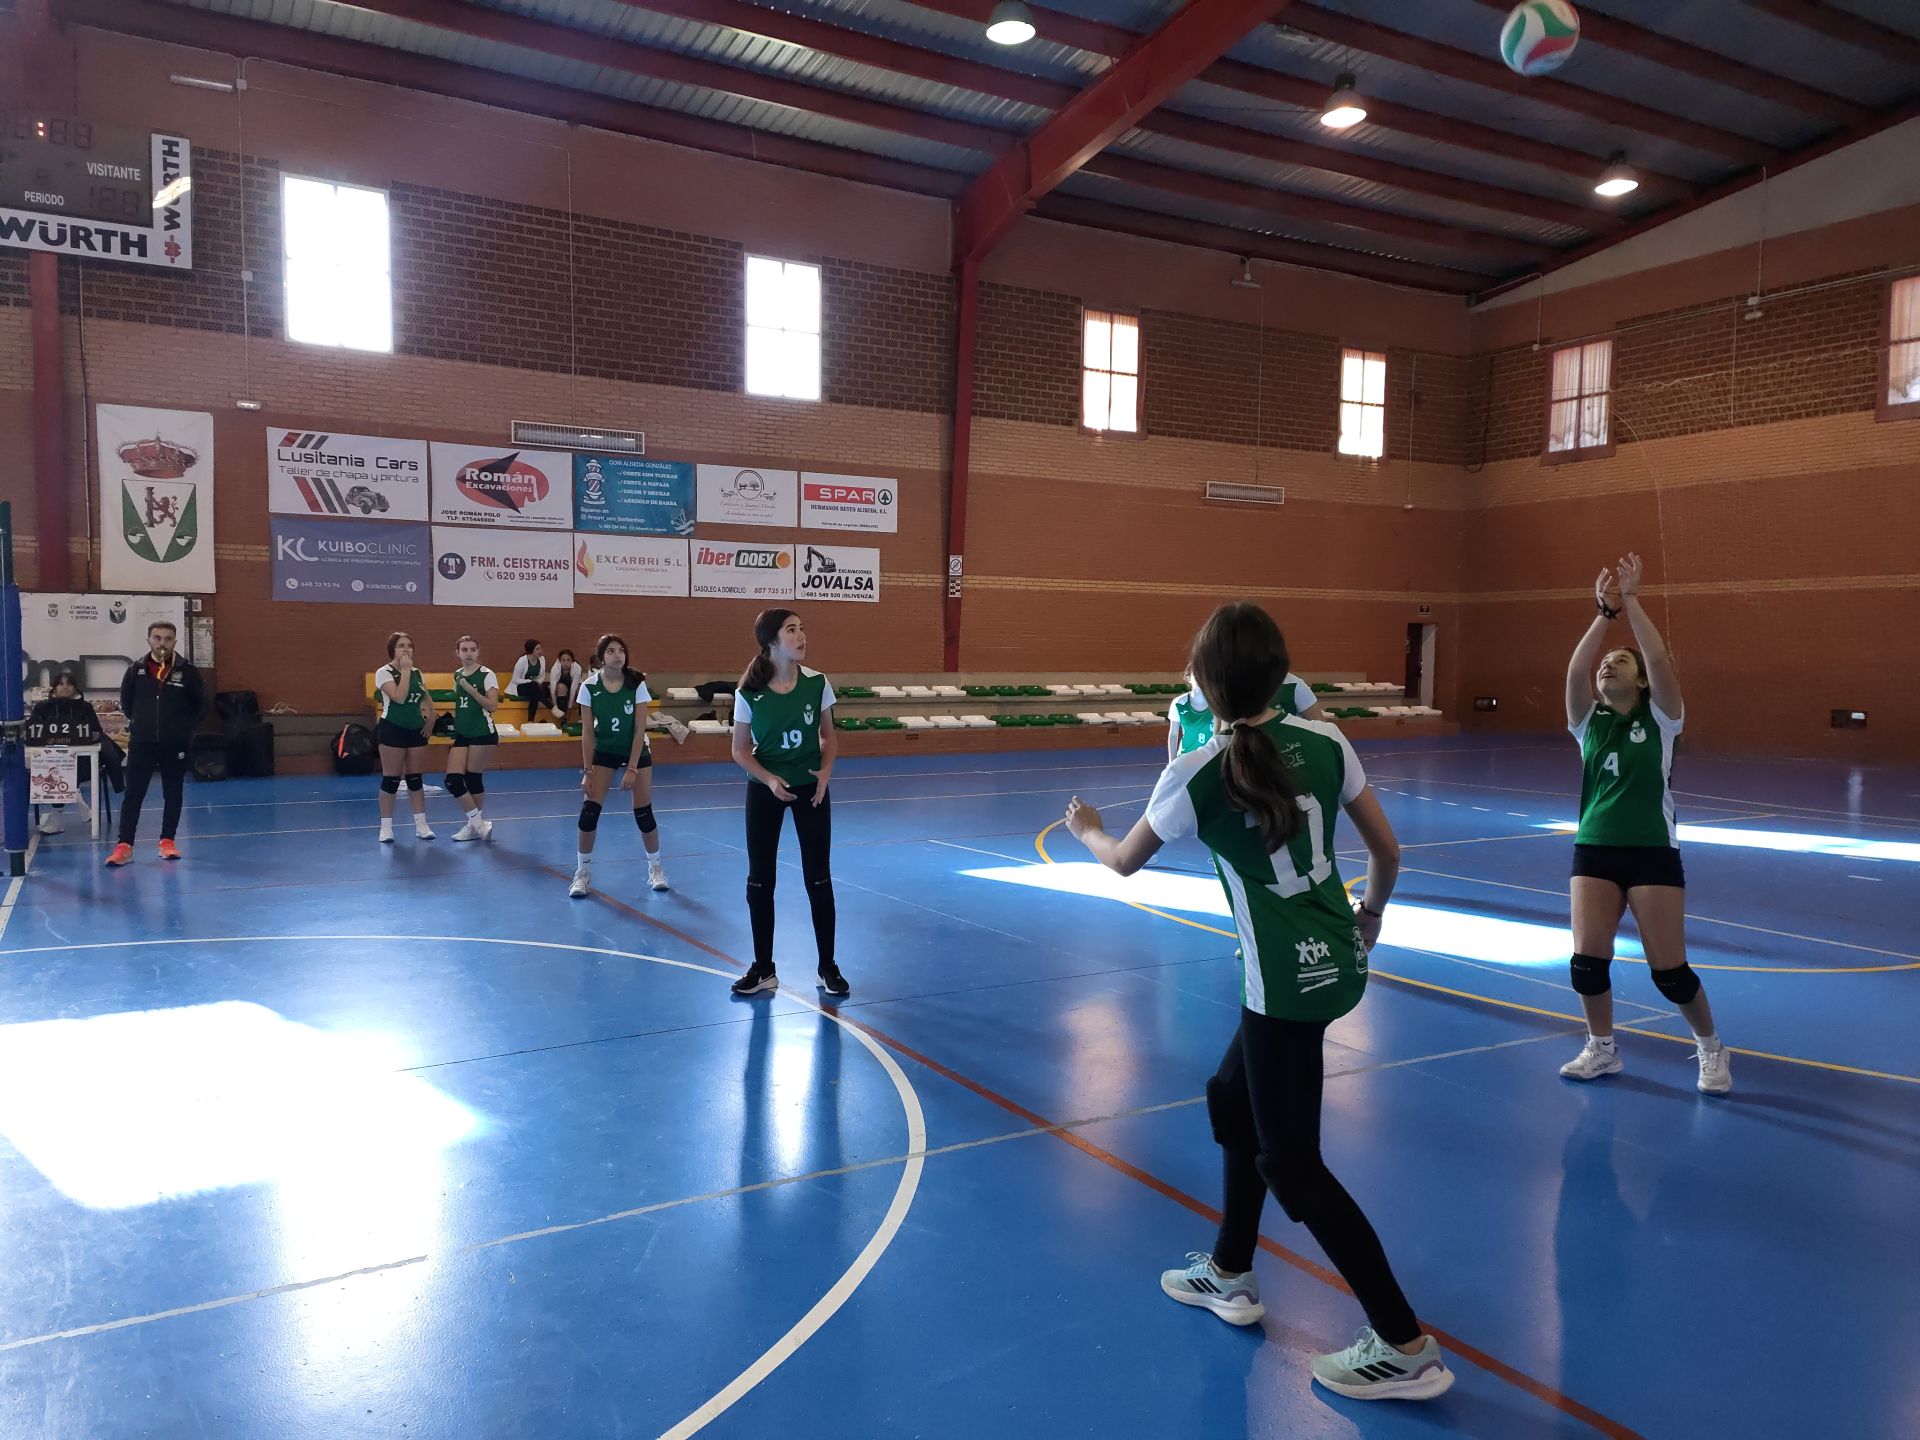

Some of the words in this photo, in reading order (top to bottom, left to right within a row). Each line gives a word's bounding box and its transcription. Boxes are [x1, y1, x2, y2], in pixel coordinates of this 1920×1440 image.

[86, 162, 141, 181] VISITANTE
[162, 138, 180, 231] WRTH
[24, 190, 64, 206] PERIODO
[0, 216, 148, 258] WÜRTH
[277, 448, 365, 468] Lusitania
[376, 456, 418, 471] Cars
[279, 466, 314, 476] Taller
[316, 468, 330, 478] de
[332, 470, 368, 480] chapa
[370, 474, 378, 482] y
[380, 474, 419, 484] pintura
[465, 468, 538, 489] Román
[466, 481, 533, 493] Excavaciones
[819, 488, 874, 502] SPAR
[318, 540, 417, 556] KUIBOCLINIC
[470, 556, 500, 568] FRM.
[503, 557, 570, 570] CEISTRANS
[596, 555, 659, 566] EXCARBRI
[496, 572, 516, 580] 620
[518, 572, 537, 581] 939
[540, 573, 558, 582] 544
[801, 574, 874, 590] JOVALSA
[459, 697, 469, 708] 12
[29, 724, 44, 738] 17
[50, 723, 58, 733] 0
[62, 723, 70, 734] 2
[76, 724, 90, 738] 11
[611, 717, 620, 732] 2
[781, 729, 802, 749] 19
[1198, 733, 1206, 744] 8
[1604, 752, 1619, 776] 4
